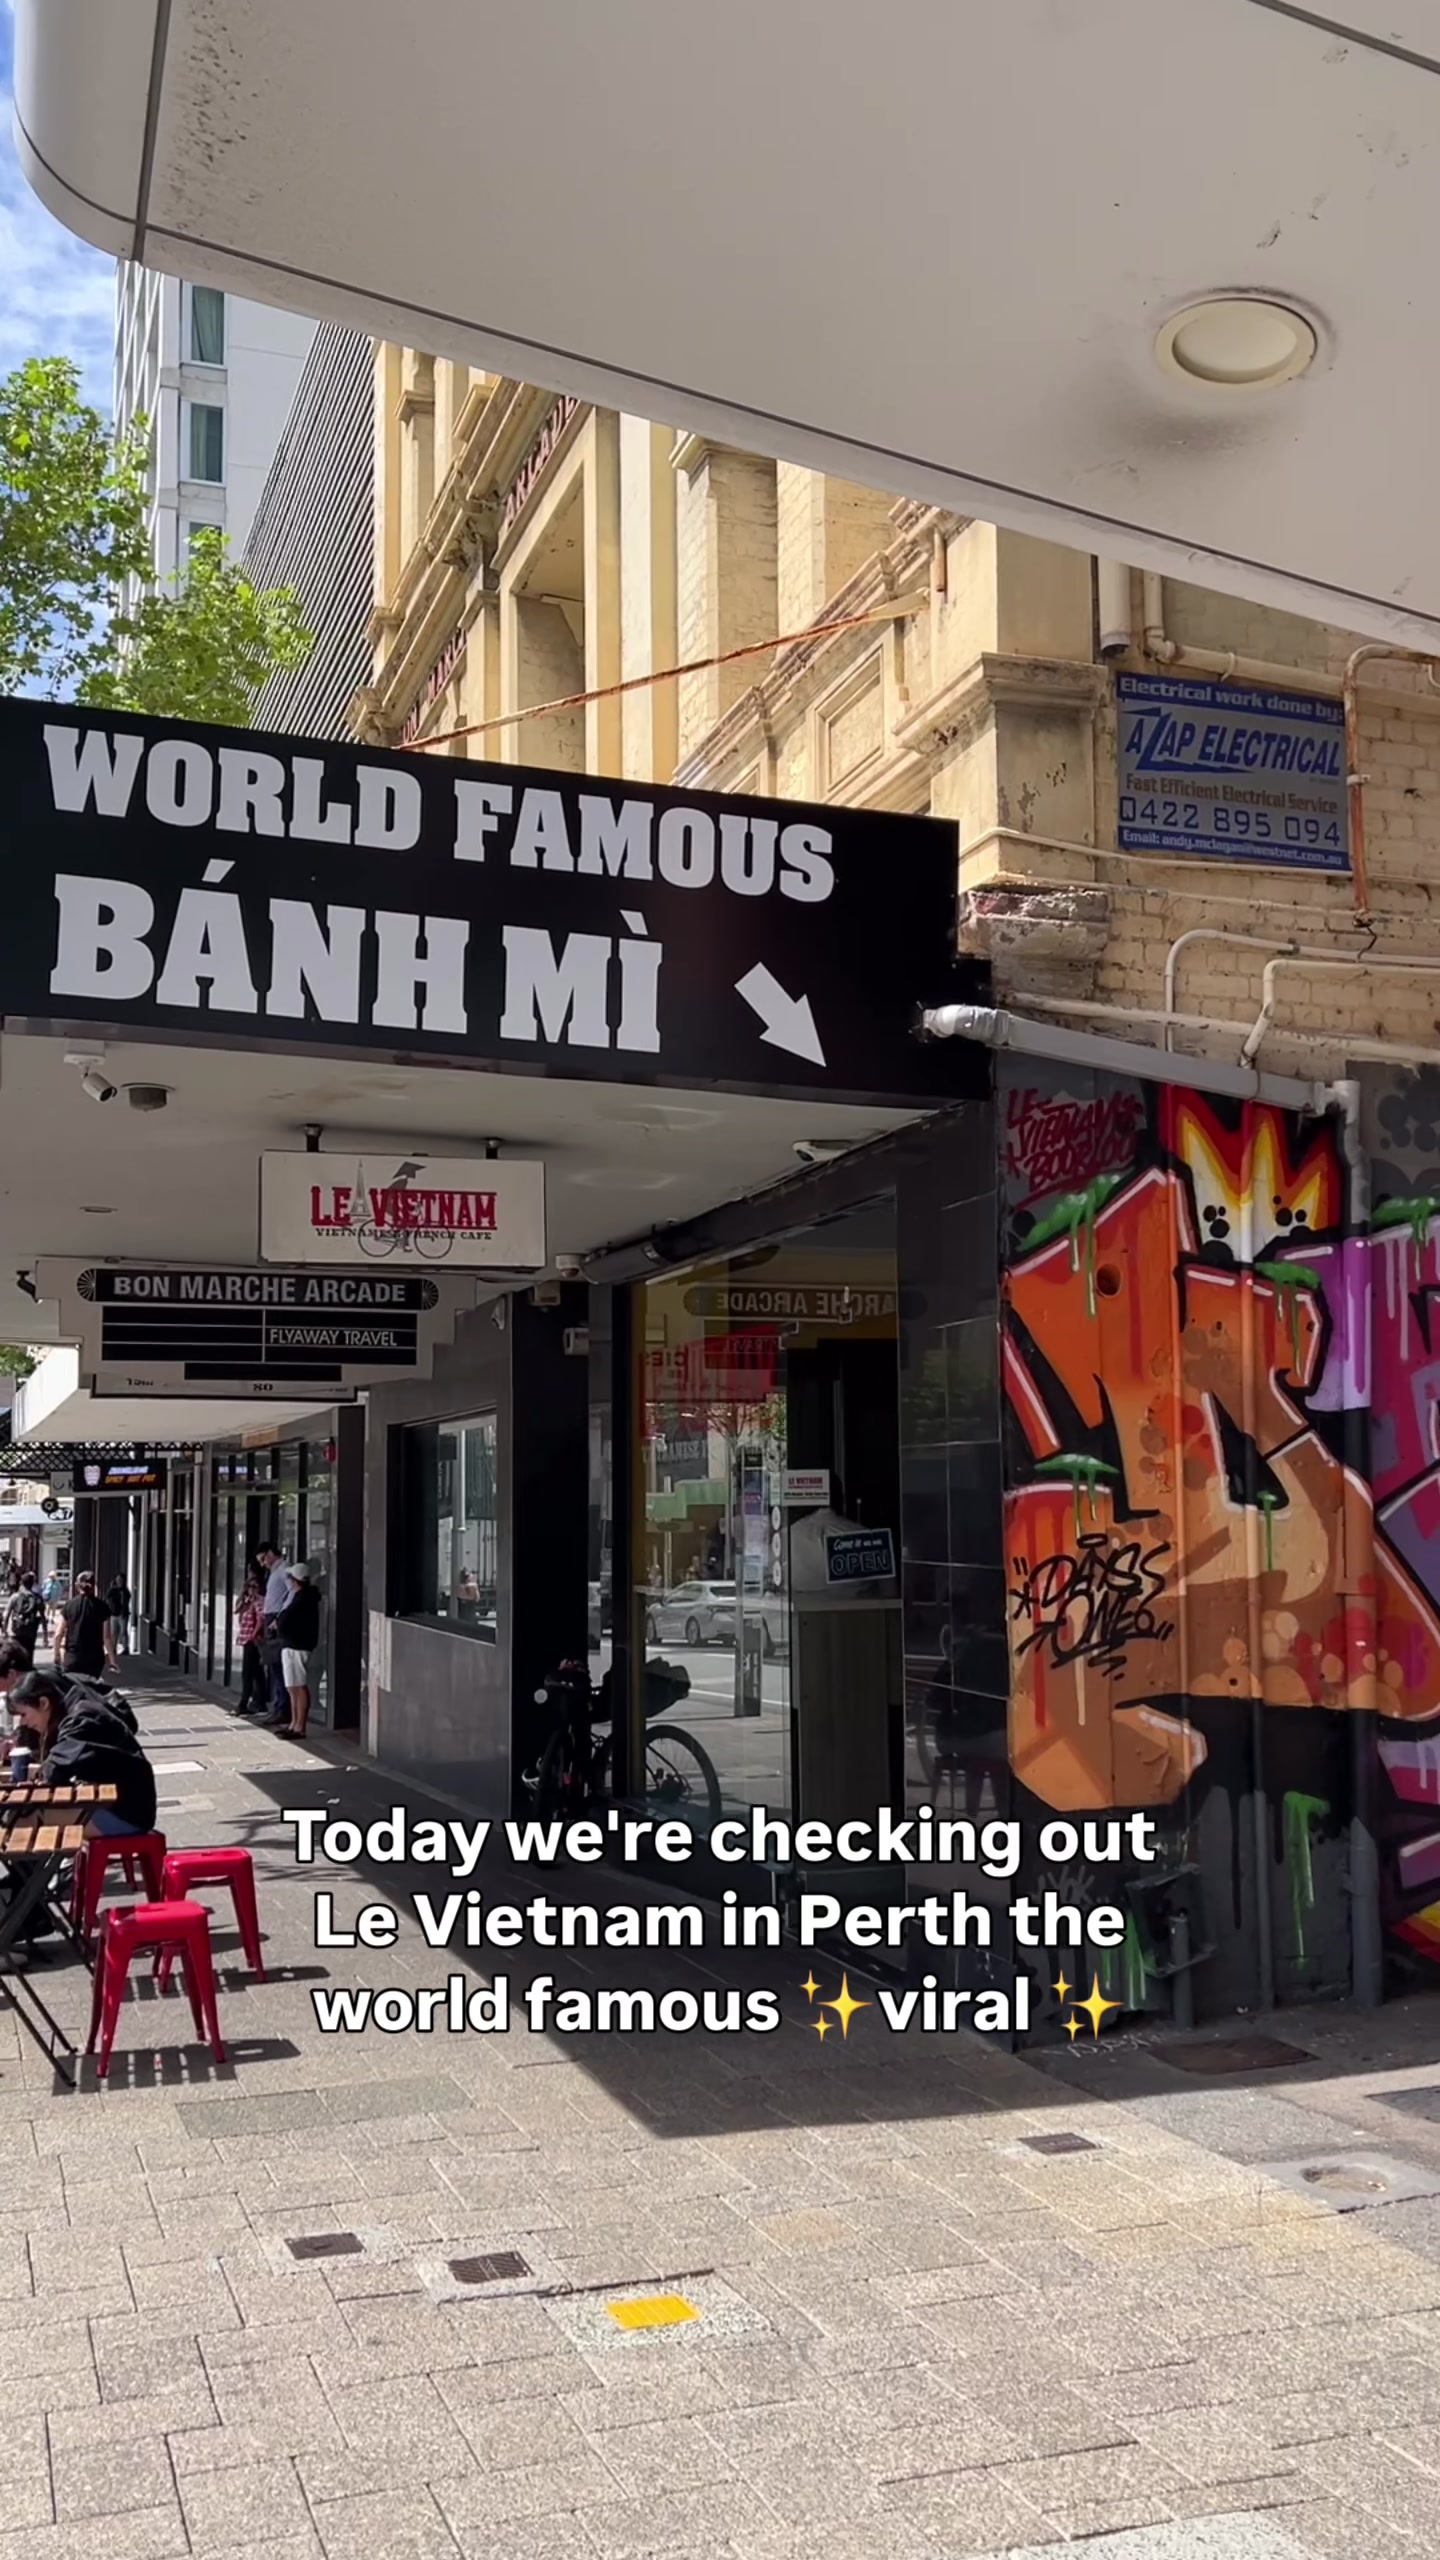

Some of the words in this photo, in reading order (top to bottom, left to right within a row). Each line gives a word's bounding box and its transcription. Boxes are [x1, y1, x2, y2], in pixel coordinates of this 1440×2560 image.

[1121, 678, 1212, 701] Electrical
[1215, 690, 1262, 708] work
[1267, 695, 1313, 715] done
[1316, 702, 1344, 722] by:
[1197, 724, 1340, 777] ELECTRICAL
[43, 724, 423, 851] WORLD
[453, 778, 836, 903] FAMOUS
[1126, 773, 1158, 793] Fast
[1161, 777, 1220, 800] Efficient
[1222, 784, 1286, 809] Electrical
[1288, 793, 1338, 814] Service
[1120, 796, 1200, 830] 0422
[1213, 806, 1271, 838] 895
[1284, 815, 1341, 848] 094
[1123, 829, 1160, 844] Email:
[50, 859, 470, 1035] BÁNH
[499, 909, 664, 1054] MÌ
[311, 1185, 351, 1227] LE
[368, 1187, 498, 1231] VIETNAM
[460, 1231, 493, 1241] CAFE
[113, 1275, 170, 1298] BON
[180, 1276, 297, 1303] MARCHE
[304, 1282, 406, 1303] ARCADE
[269, 1327, 340, 1345] FLYAWAY
[344, 1330, 398, 1347] TRAVEL
[830, 1549, 891, 1577] OPEN
